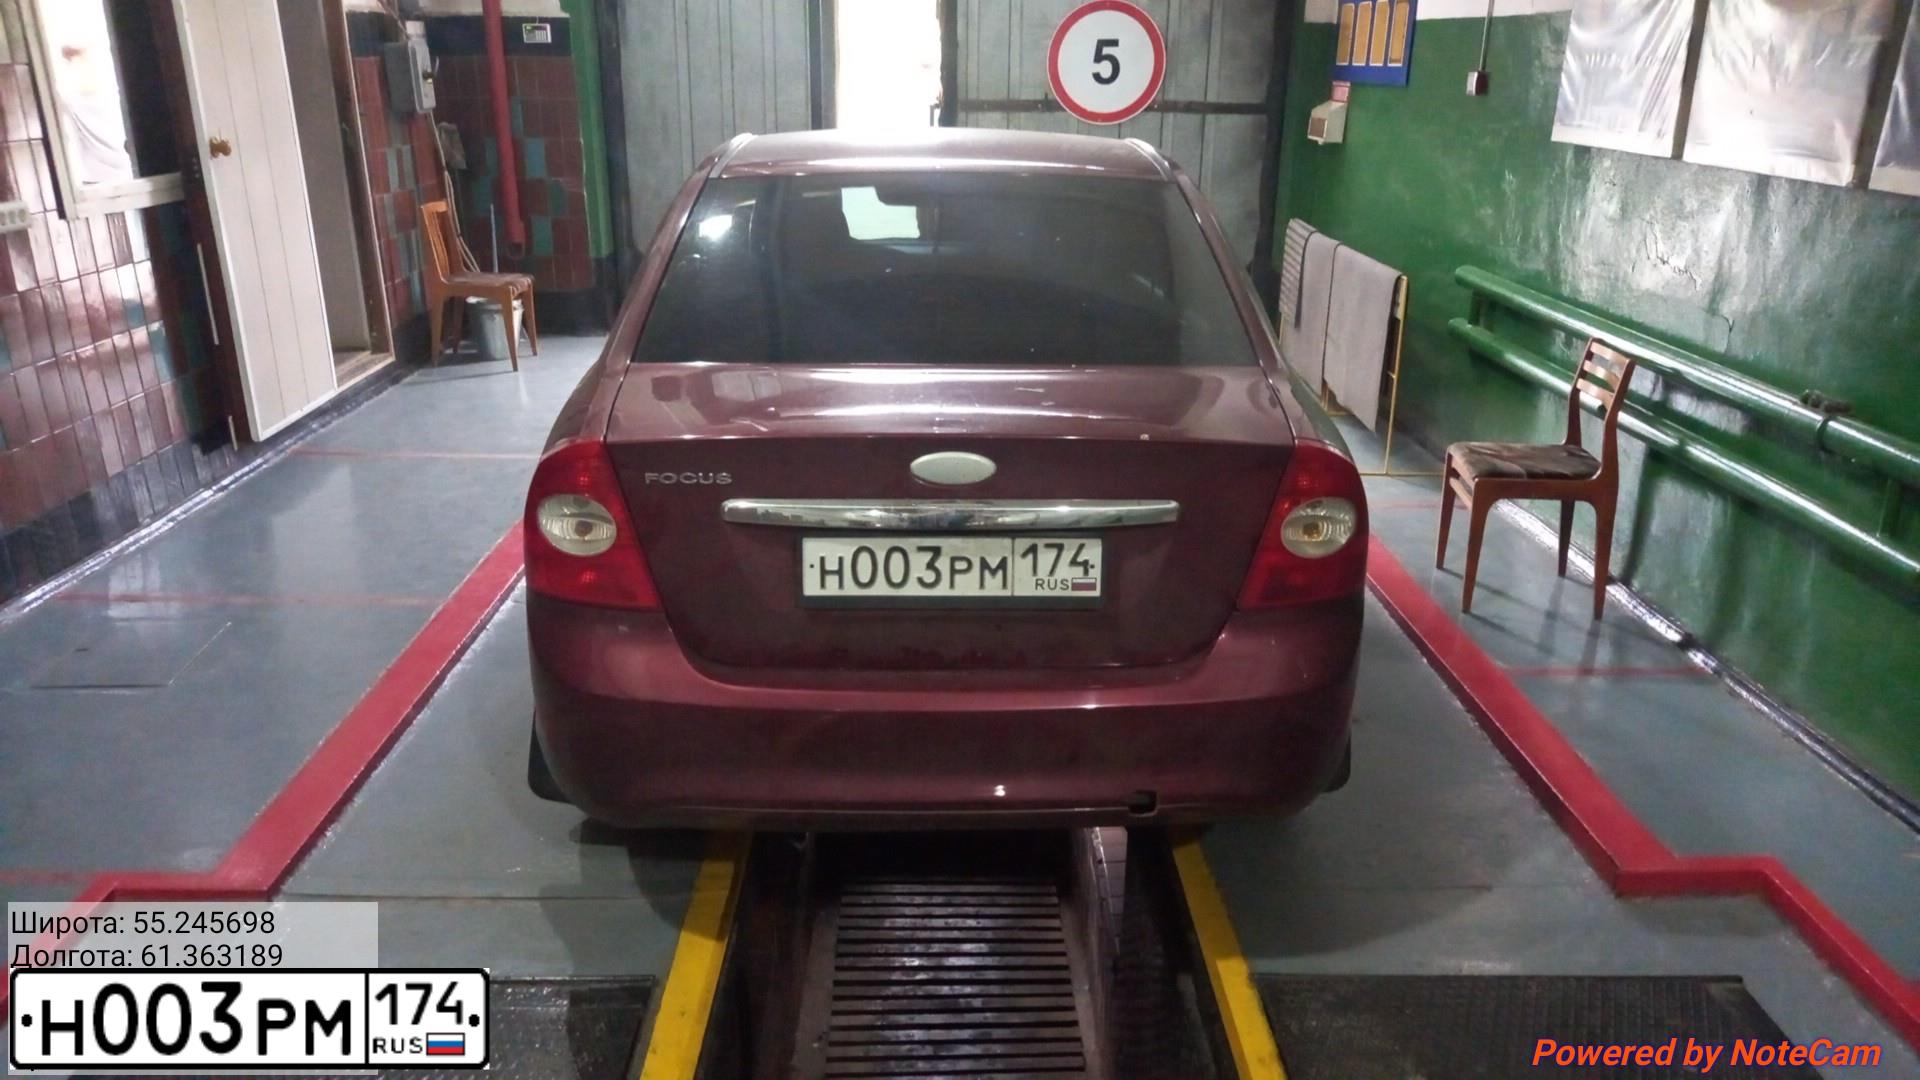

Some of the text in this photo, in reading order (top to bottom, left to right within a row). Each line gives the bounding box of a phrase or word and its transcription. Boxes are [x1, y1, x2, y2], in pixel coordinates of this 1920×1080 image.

[1092, 38, 1120, 85] 5
[644, 472, 732, 485] FOCUS
[1020, 543, 1091, 577] 174
[1035, 578, 1069, 590] RUS
